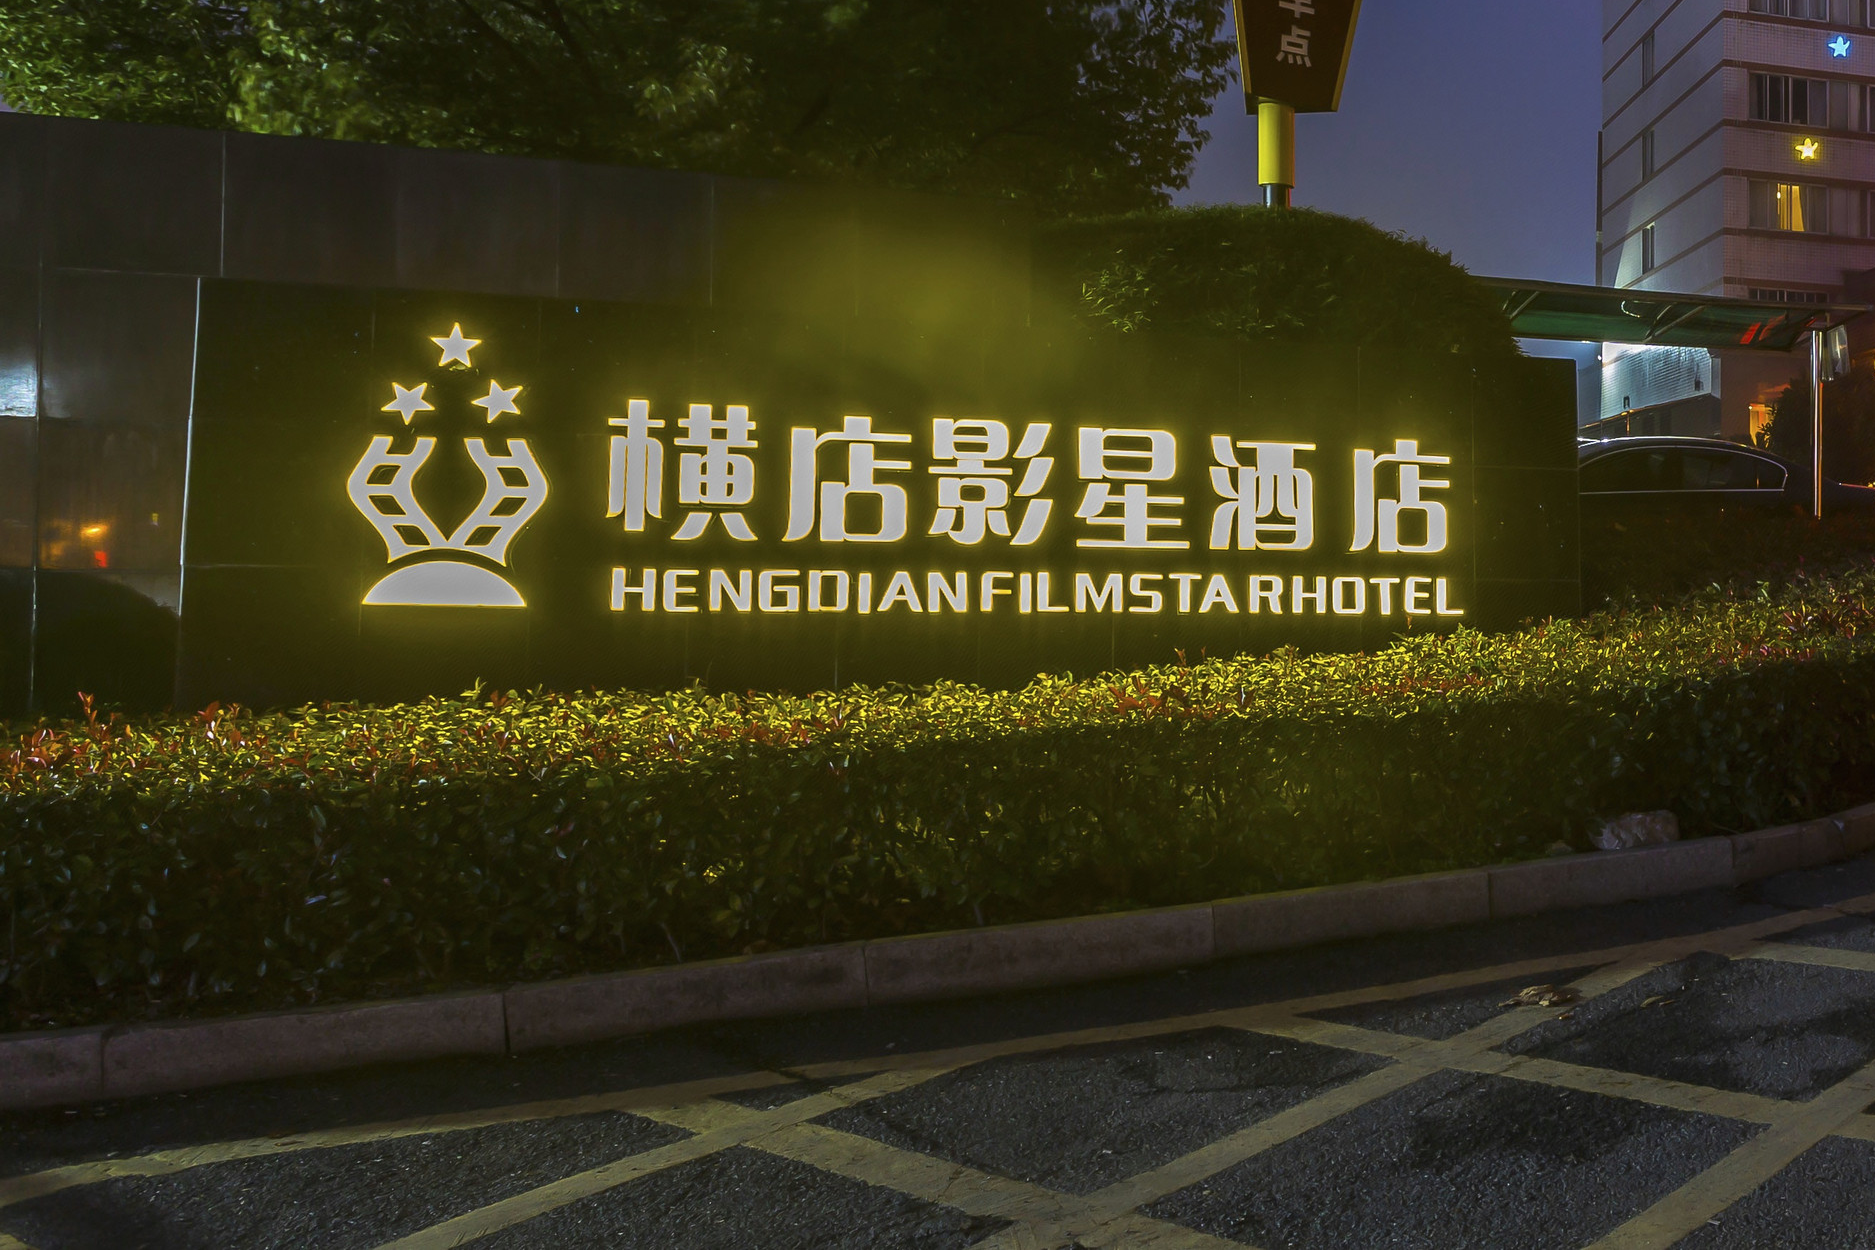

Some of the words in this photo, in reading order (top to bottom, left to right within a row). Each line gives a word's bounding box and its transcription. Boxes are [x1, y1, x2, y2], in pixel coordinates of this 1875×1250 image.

[607, 398, 1452, 554] 横店影星酒店
